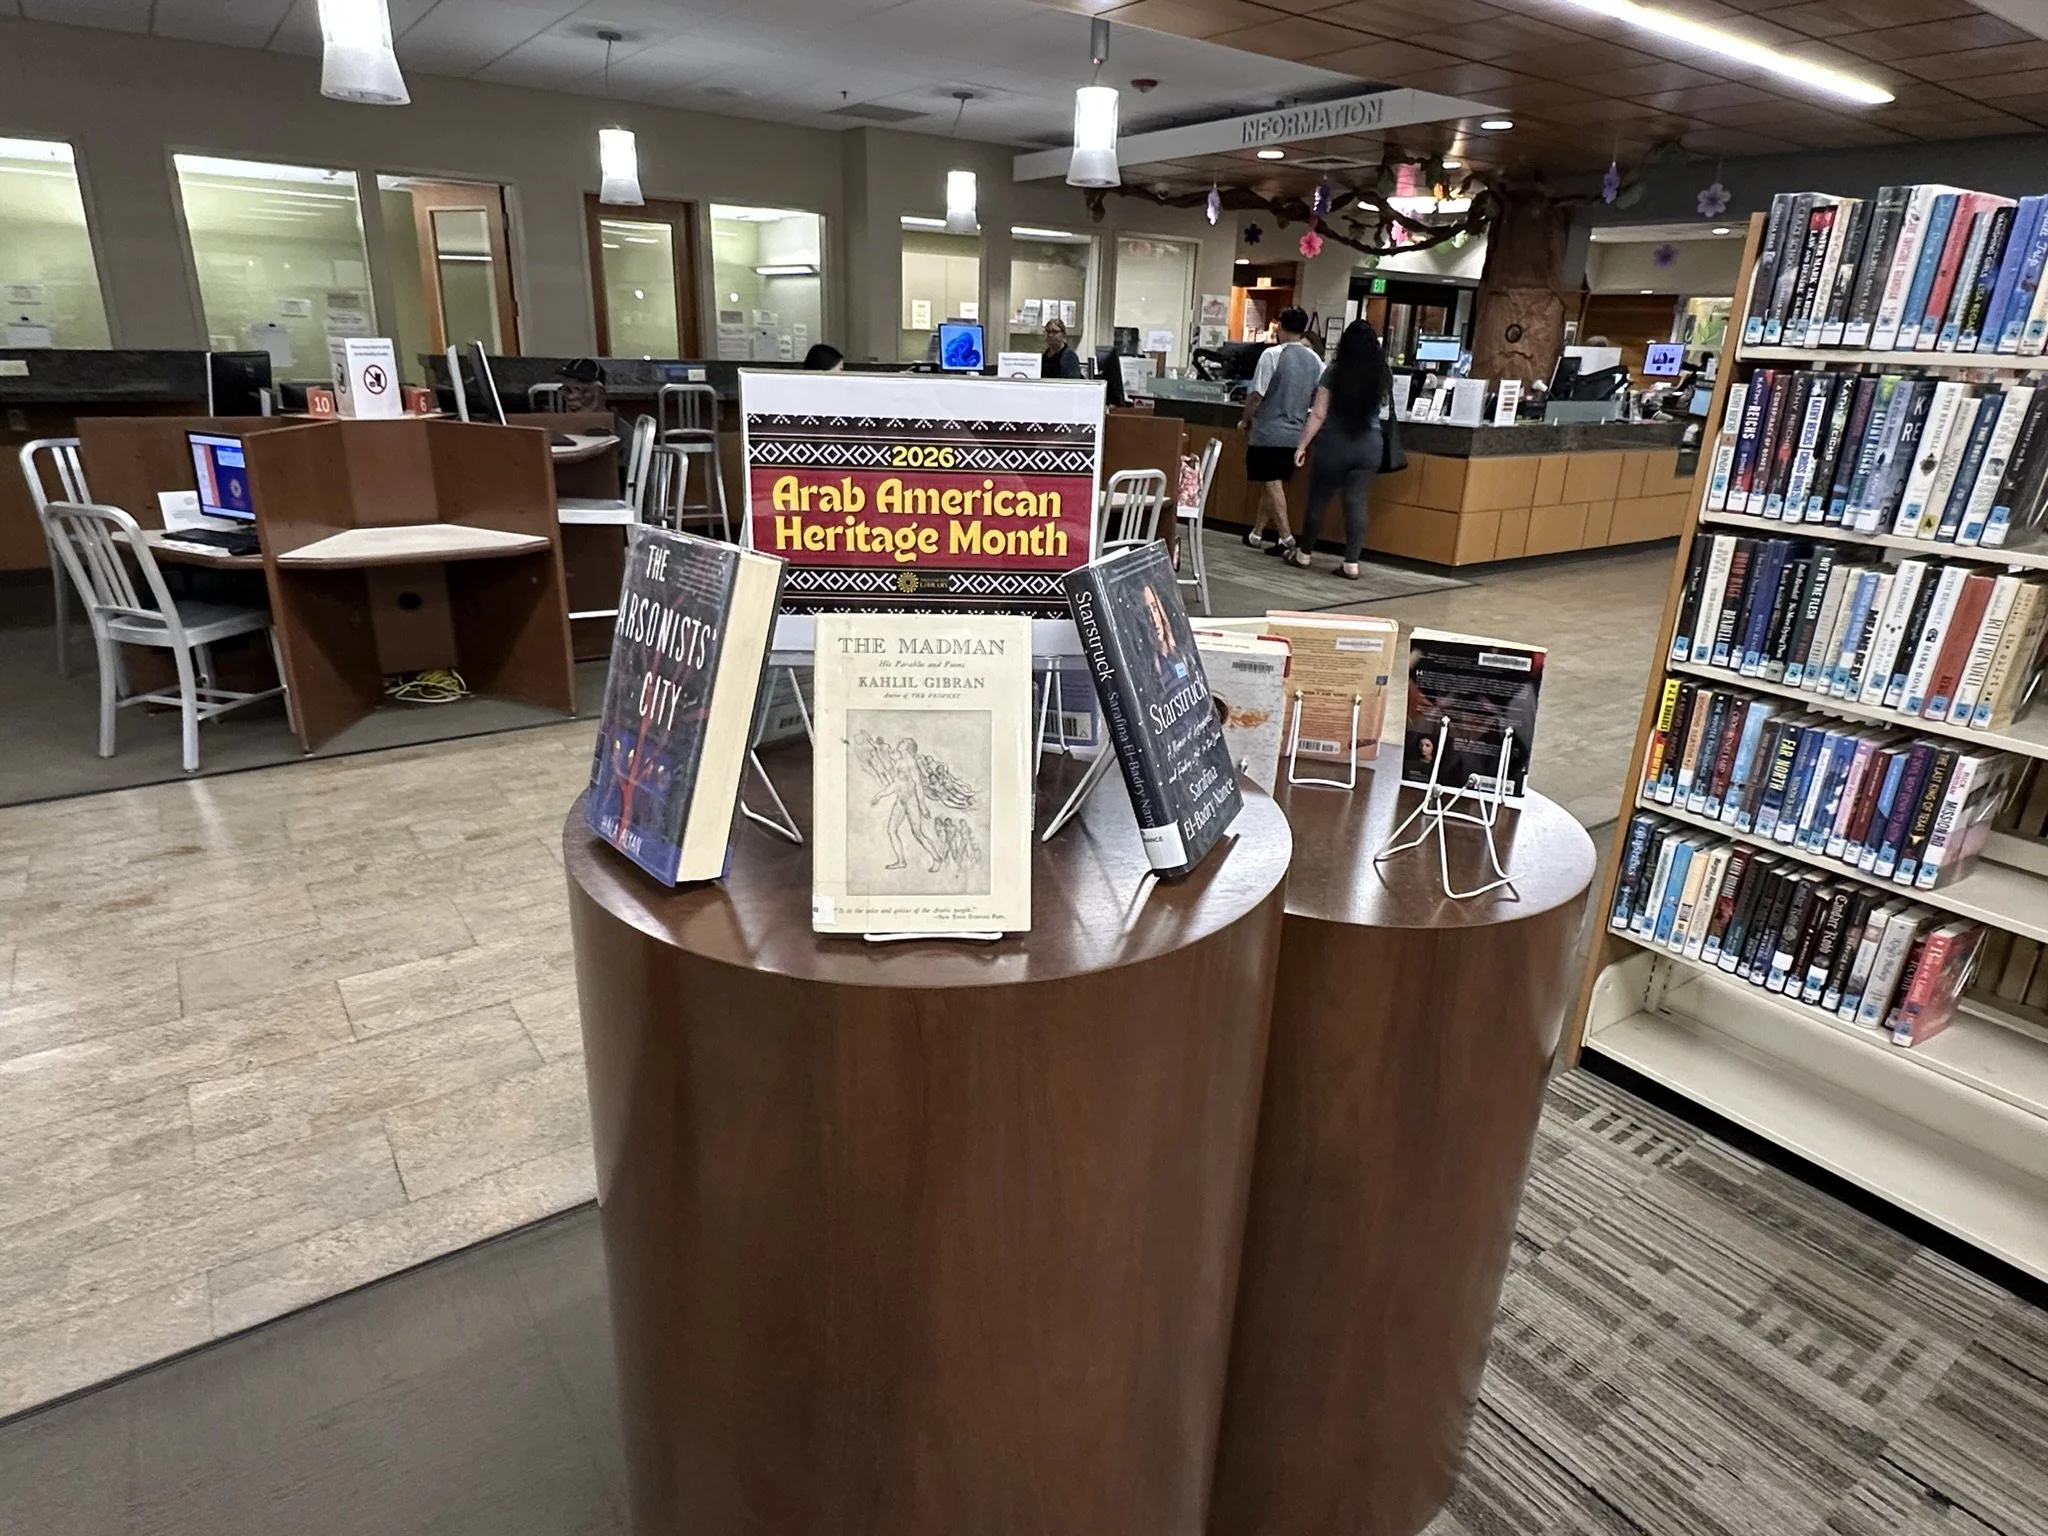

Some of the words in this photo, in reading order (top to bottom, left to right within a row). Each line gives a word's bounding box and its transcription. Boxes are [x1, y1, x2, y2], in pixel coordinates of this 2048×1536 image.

[1242, 98, 1384, 144] INFORMATION
[1793, 206, 1806, 234] CRAZY
[1880, 219, 1888, 232] ALL
[1807, 229, 1818, 248] LAW
[1815, 226, 1829, 256] WATER
[1987, 212, 2005, 254] VANISHING
[2027, 240, 2048, 268] Trip
[1809, 257, 1822, 284] MARK
[1980, 256, 1992, 278] GIRLS
[1862, 278, 1873, 297] GIVE
[1974, 282, 1986, 301] LISA
[1859, 299, 1868, 310] TO
[1752, 377, 1764, 404] KATHY
[1792, 378, 1806, 409] KATHY
[1836, 379, 1853, 417] KATHY
[1942, 387, 1955, 411] RUTH
[313, 396, 330, 412] 10
[420, 397, 427, 412] 6
[1766, 393, 1781, 434] CONSPIRACY
[1808, 398, 1823, 420] KATHY
[1742, 405, 1761, 439] REICHS
[1782, 415, 1798, 450] REICHS
[1802, 421, 1818, 446] REICHS
[1868, 411, 1885, 440] KATHY
[1930, 413, 1947, 450] RENDELL
[1976, 425, 1988, 441] THE
[1763, 437, 1771, 446] OF
[1825, 424, 1841, 461] REICHS
[1969, 444, 1981, 463] BEST
[892, 446, 956, 468] 2026
[1758, 449, 1769, 472] BONES
[1796, 450, 1810, 474] CROSS
[1858, 443, 1877, 475] REICHS
[2013, 457, 2024, 472] Box
[772, 475, 866, 514] Arab
[876, 478, 1061, 518] American
[775, 515, 939, 563] Heritage
[950, 520, 1069, 557] Month
[646, 545, 667, 582] THE
[1796, 563, 1805, 578] Ruth
[1819, 556, 1831, 571] NOT
[1903, 564, 1917, 586] RUTH
[1791, 578, 1802, 599] Rendell
[1816, 572, 1826, 582] IN
[1944, 569, 1957, 591] RUTH
[1812, 582, 1824, 597] THE
[1787, 602, 1795, 611] No
[1806, 597, 1820, 619] FLESH
[1893, 587, 1910, 619] RENDELL
[1933, 592, 1949, 624] RENDELL
[1717, 609, 1737, 642] RENDELL
[1784, 611, 1794, 626] More
[1858, 609, 1878, 650] MEANS
[1075, 590, 1115, 683] Starstruck
[1778, 625, 1790, 644] Dying
[1981, 616, 2004, 647] RUTH
[2003, 632, 2016, 650] the
[837, 638, 886, 654] THE
[899, 638, 1006, 655] MADMAN
[1775, 644, 1786, 658] Then
[1917, 645, 1932, 670] HARM
[1849, 666, 1861, 682] EV
[1966, 646, 1993, 688] RENDELL
[858, 676, 919, 689] KAHLIL
[924, 676, 985, 689] GIBRAN
[1908, 671, 1923, 695] DONE
[638, 672, 683, 731] CITY
[1150, 675, 1209, 736] Starstruck
[1715, 702, 1723, 713] THE
[1708, 714, 1720, 738] WINTER
[1686, 729, 1699, 757] SEASON
[1779, 738, 1796, 757] FAR
[1107, 690, 1130, 750] Sarafina
[1121, 743, 1147, 799] El-Badry
[1138, 798, 1155, 828] Nanc
[1937, 752, 1949, 766] THE
[1189, 766, 1218, 801] Sarafina
[1770, 759, 1791, 790] NORTH
[1931, 766, 1944, 783] LAST
[1949, 762, 1965, 794] RIORDAN
[1959, 771, 1969, 788] RICK
[1844, 785, 1855, 798] Ivy
[1925, 782, 1938, 801] KING
[1184, 798, 1216, 840] El-Badry
[1211, 778, 1235, 808] Nance
[1921, 800, 1932, 812] OF
[1936, 799, 1958, 834] MISSION
[1915, 811, 1929, 832] TEXAS
[1827, 894, 1849, 928] Candace
[1819, 928, 1838, 955] Robb
